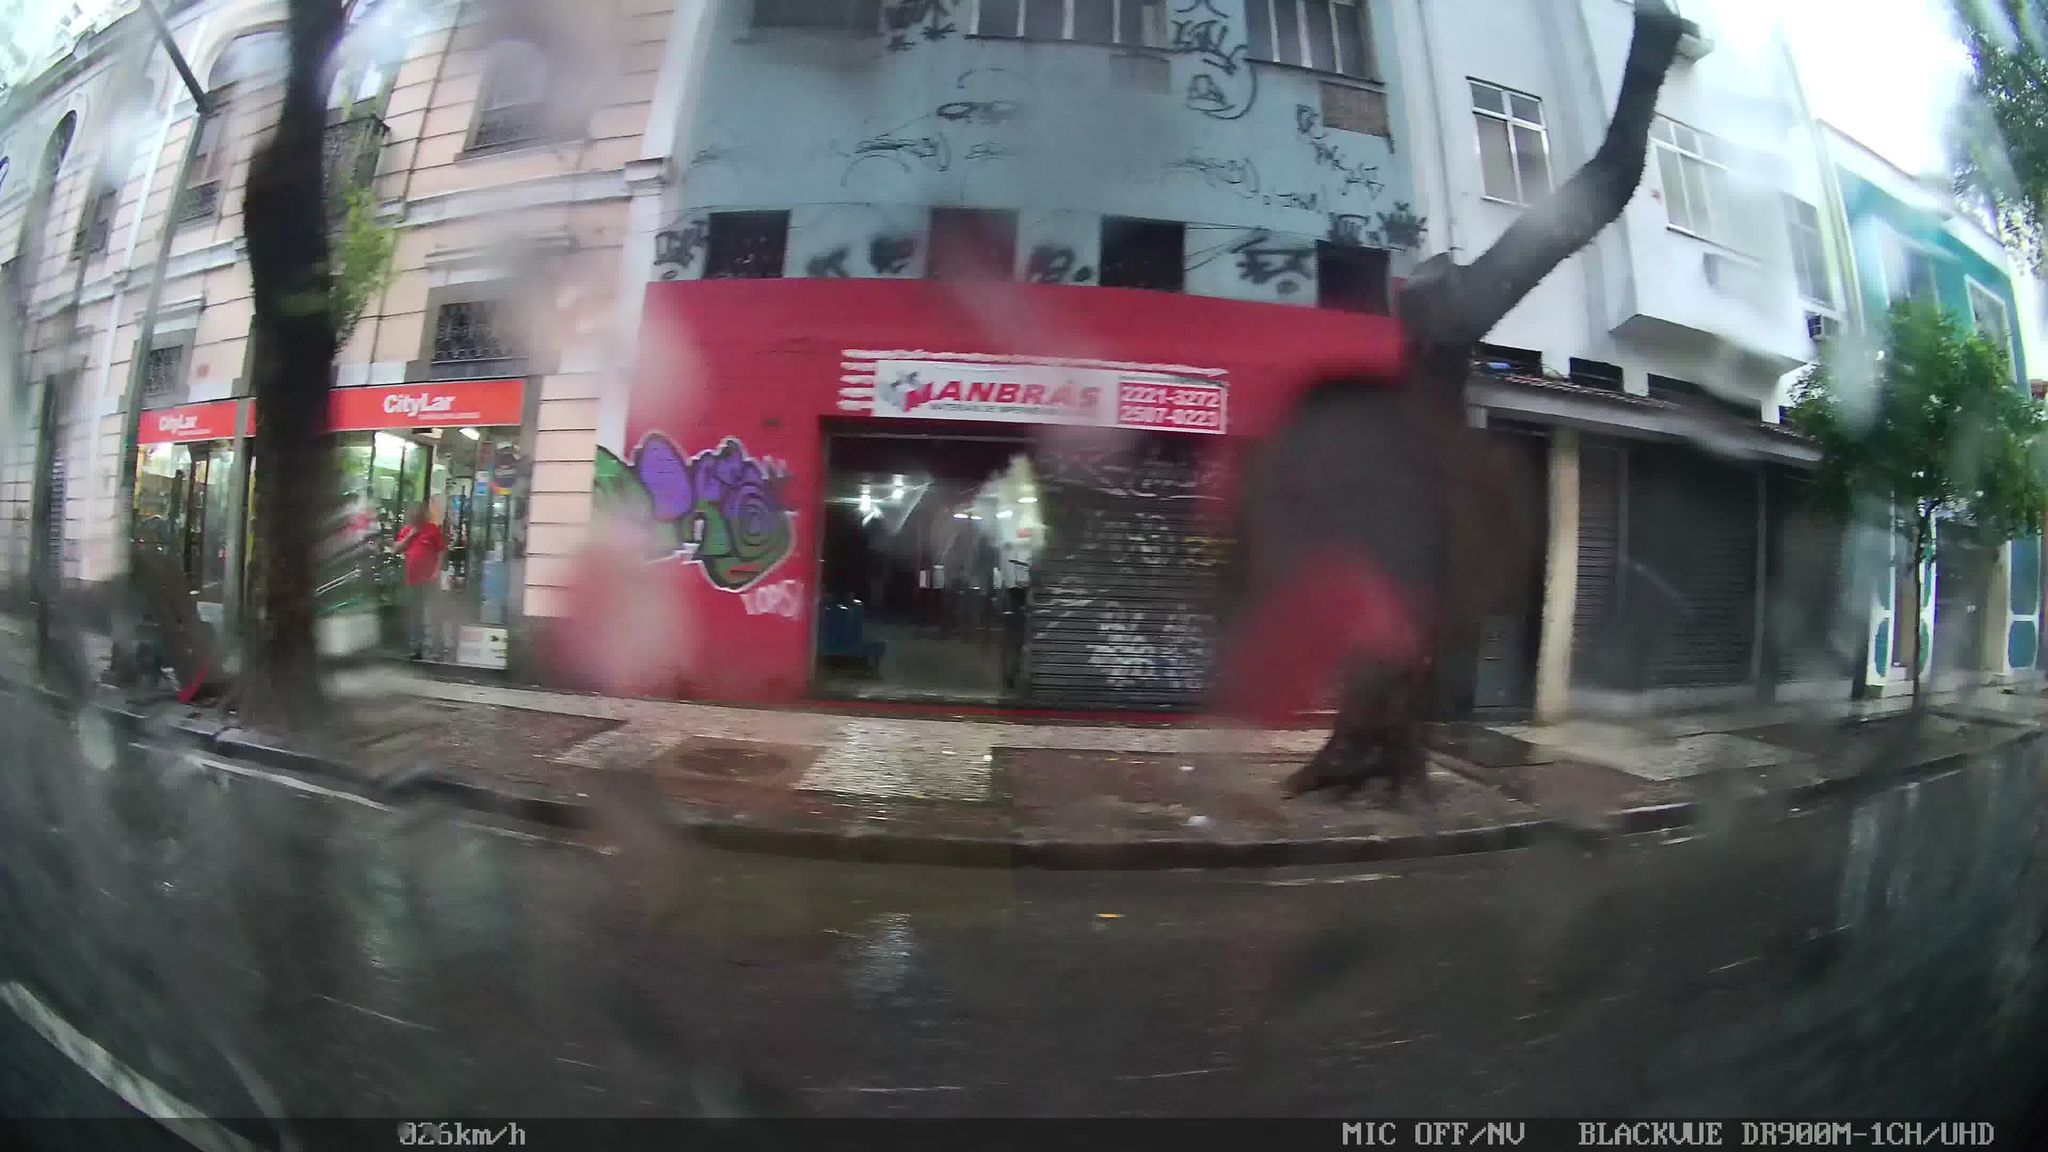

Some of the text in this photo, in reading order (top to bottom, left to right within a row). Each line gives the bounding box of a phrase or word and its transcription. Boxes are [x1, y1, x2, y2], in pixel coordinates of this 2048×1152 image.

[384, 393, 457, 418] CityLar
[1119, 385, 1220, 407] 2221-3272
[158, 413, 198, 434] CityLar
